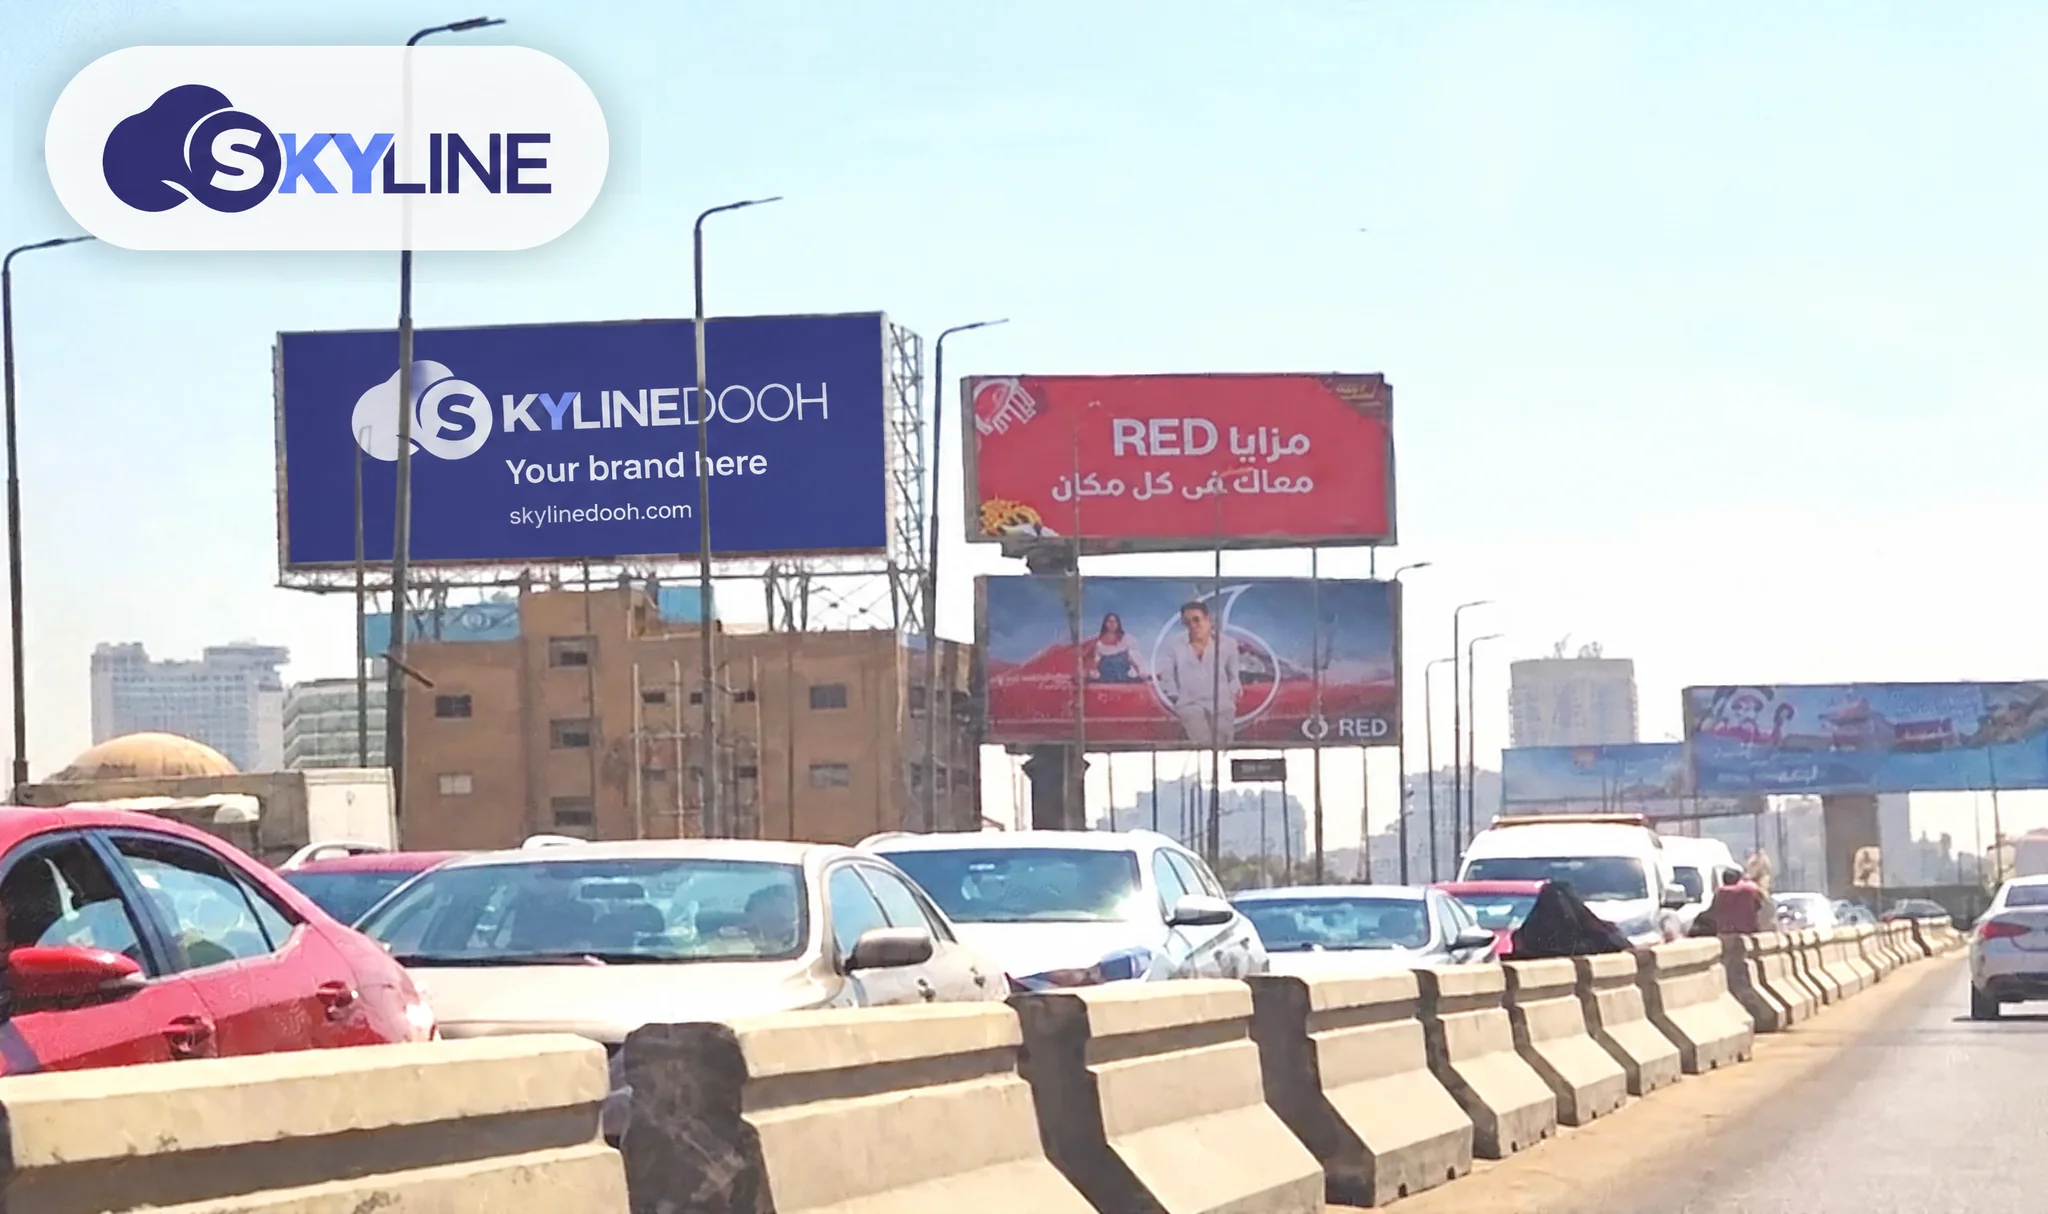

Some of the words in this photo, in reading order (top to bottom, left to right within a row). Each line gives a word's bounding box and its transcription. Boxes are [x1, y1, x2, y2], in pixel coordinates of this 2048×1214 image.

[1112, 418, 1218, 456] RED
[1230, 426, 1311, 463] مزايا
[506, 459, 580, 485] Your
[590, 451, 685, 482] brand
[695, 451, 768, 478] here
[1233, 467, 1314, 494] معاك
[1051, 472, 1126, 502] مكان
[1132, 471, 1174, 501] كل
[509, 503, 692, 529] skylinedooh.com
[1338, 717, 1388, 738] RED
